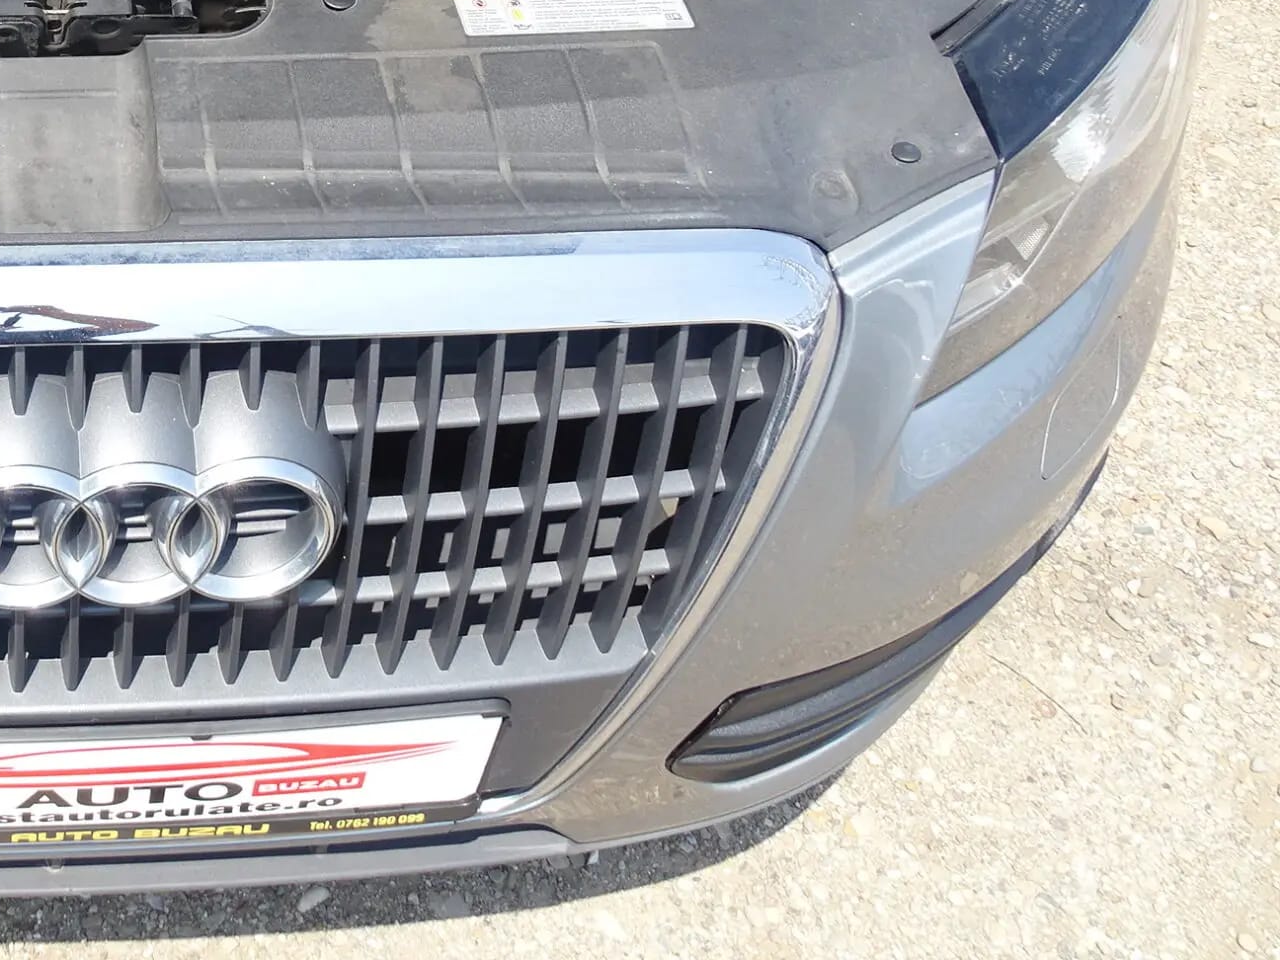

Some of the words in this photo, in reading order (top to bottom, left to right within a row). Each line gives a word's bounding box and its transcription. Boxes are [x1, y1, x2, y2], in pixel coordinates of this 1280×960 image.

[258, 777, 360, 793] BUZAU
[16, 782, 243, 808] AUTO
[11, 829, 119, 843] AUTO
[133, 823, 270, 840] BUZAU
[310, 821, 332, 830] Tel.
[336, 818, 370, 829] 0762
